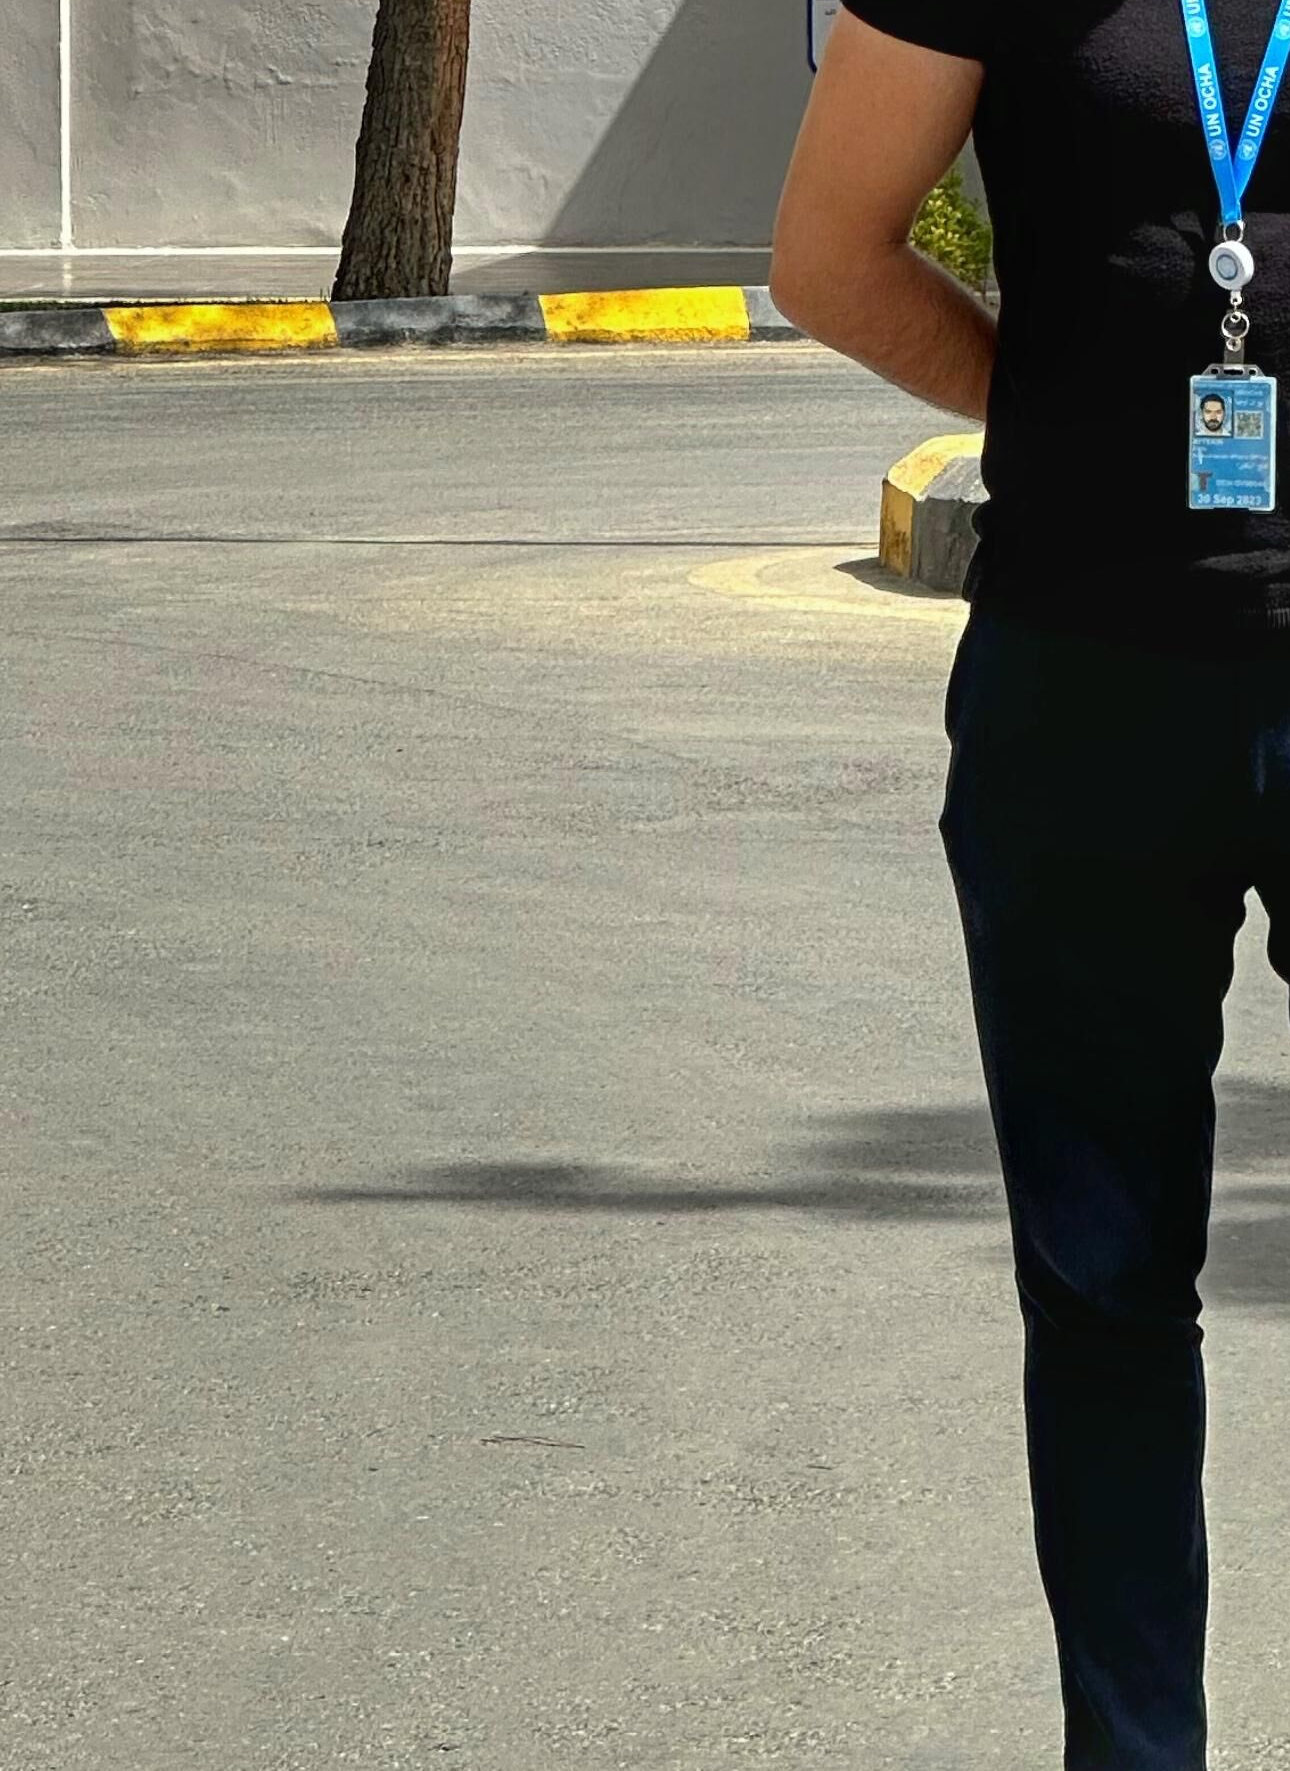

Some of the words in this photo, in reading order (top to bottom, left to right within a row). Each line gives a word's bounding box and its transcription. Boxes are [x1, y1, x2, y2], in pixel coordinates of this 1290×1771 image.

[1198, 63, 1217, 110] OCHA
[1254, 65, 1280, 111] OCHA
[1206, 113, 1222, 137] UN
[1246, 114, 1264, 138] UN
[1213, 493, 1235, 507] Sep
